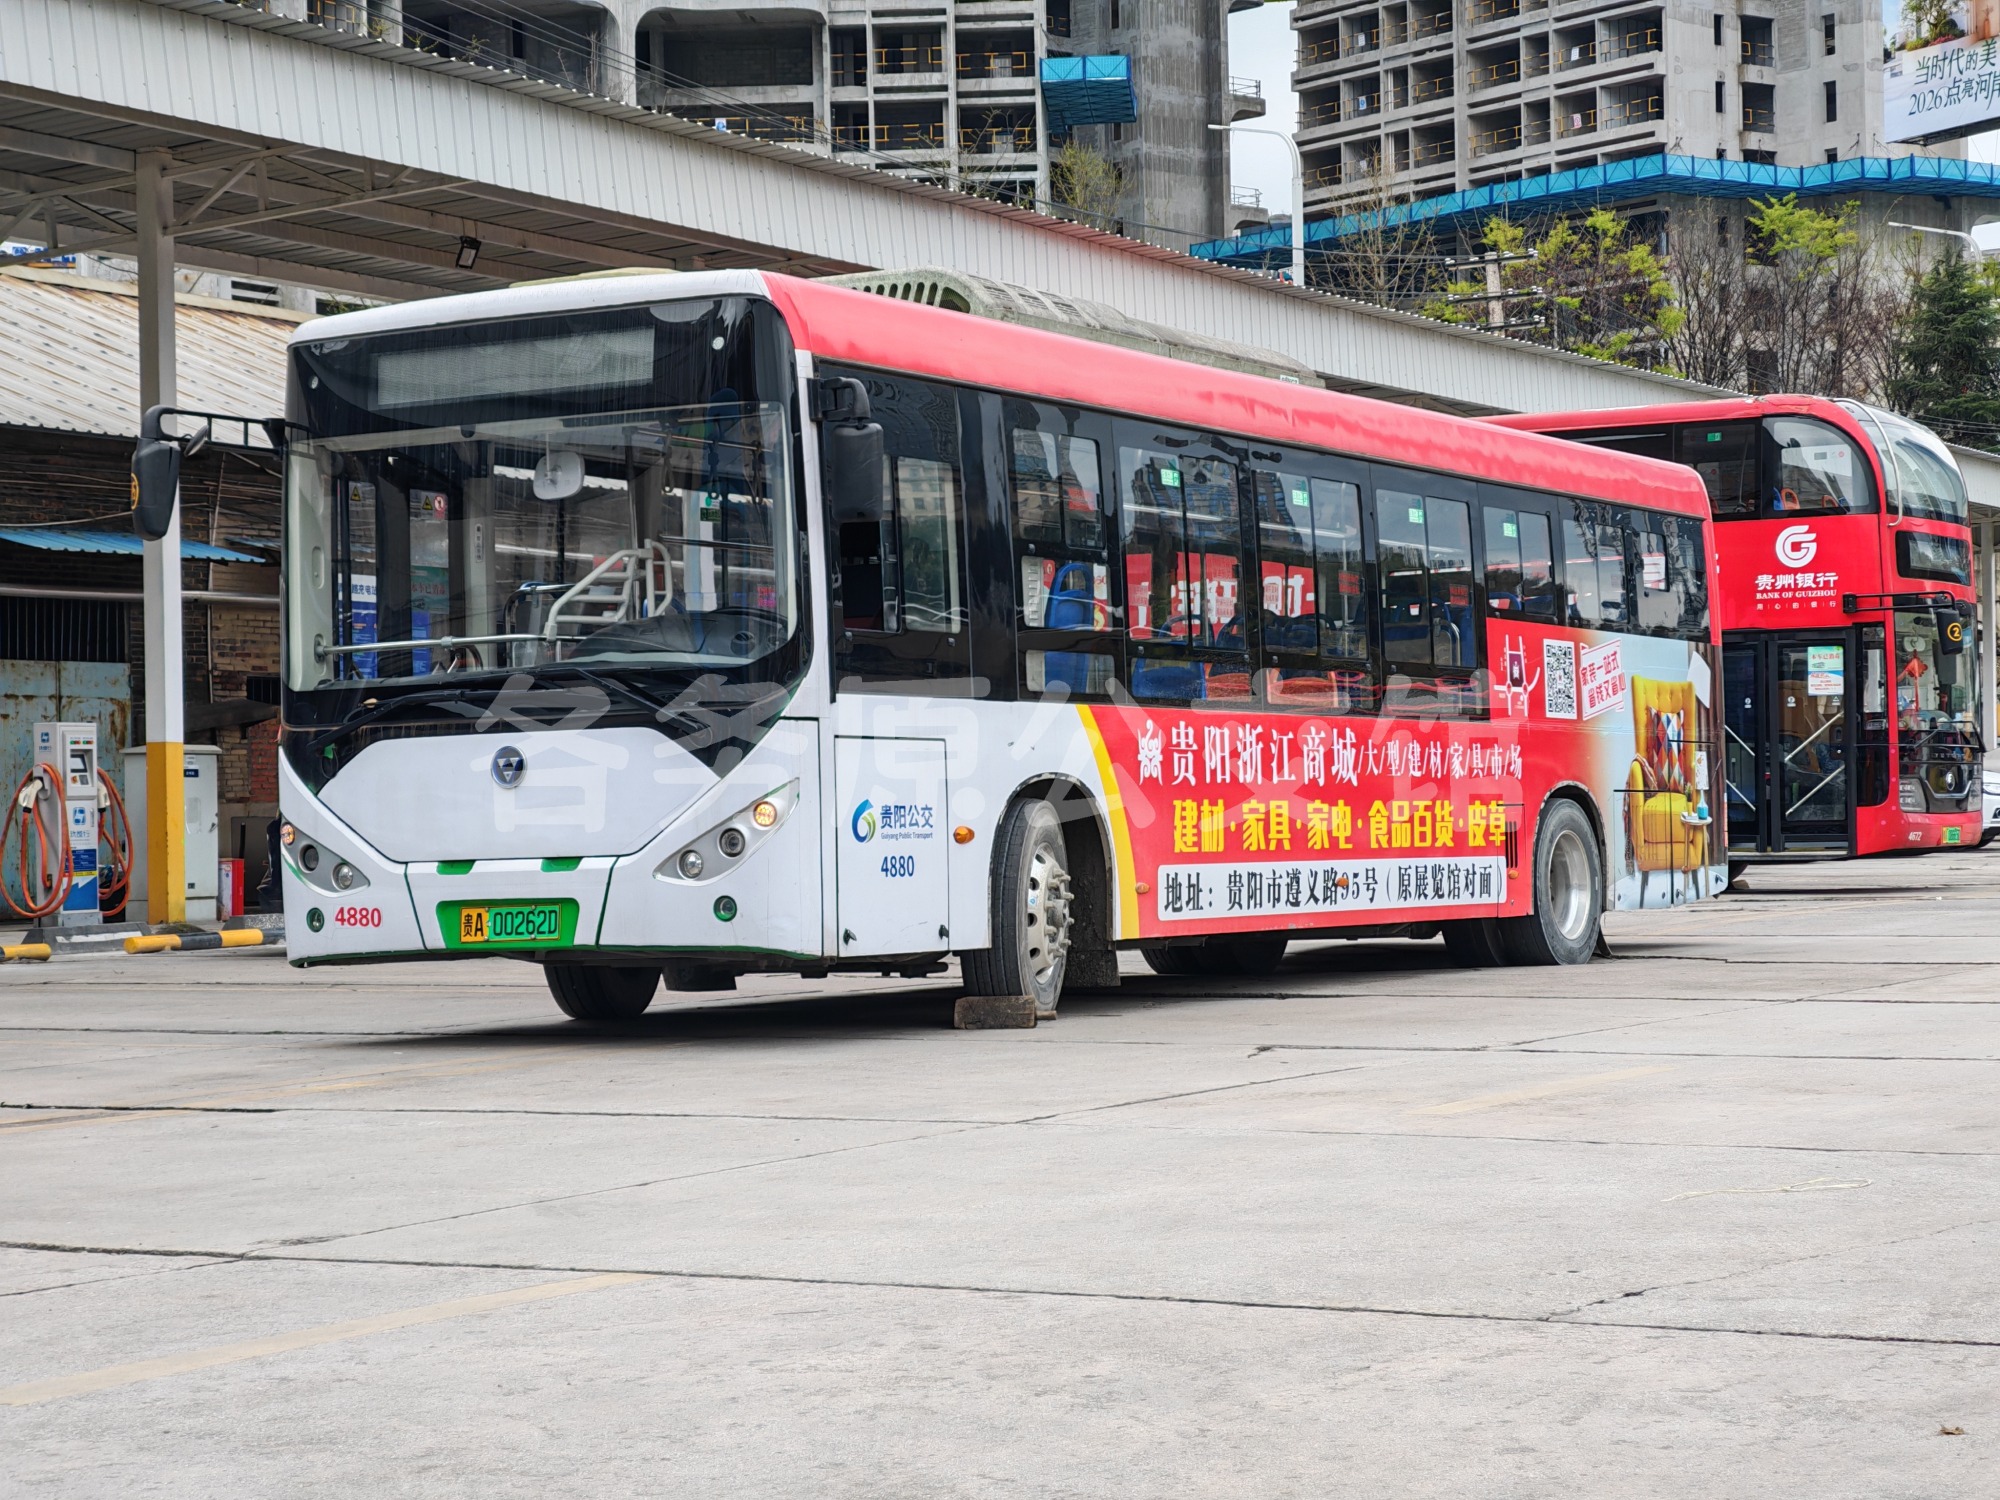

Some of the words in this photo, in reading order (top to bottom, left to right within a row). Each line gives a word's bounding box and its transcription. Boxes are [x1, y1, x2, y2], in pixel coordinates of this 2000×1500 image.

[1914, 38, 1998, 85] 当时代的美
[1754, 572, 1839, 591] 贵州银行
[1756, 591, 1780, 600] BANK
[1782, 591, 1794, 599] OF
[1795, 589, 1837, 598] GUIZHOU
[1580, 651, 1620, 687] 家装一站式
[1588, 672, 1627, 709] 省钱又省心
[880, 804, 934, 829] 贵阳公交
[881, 832, 899, 841] Guiyang
[899, 832, 912, 840] Public
[913, 832, 933, 840] Transport
[880, 855, 915, 877] 4880
[334, 906, 382, 928] 4880
